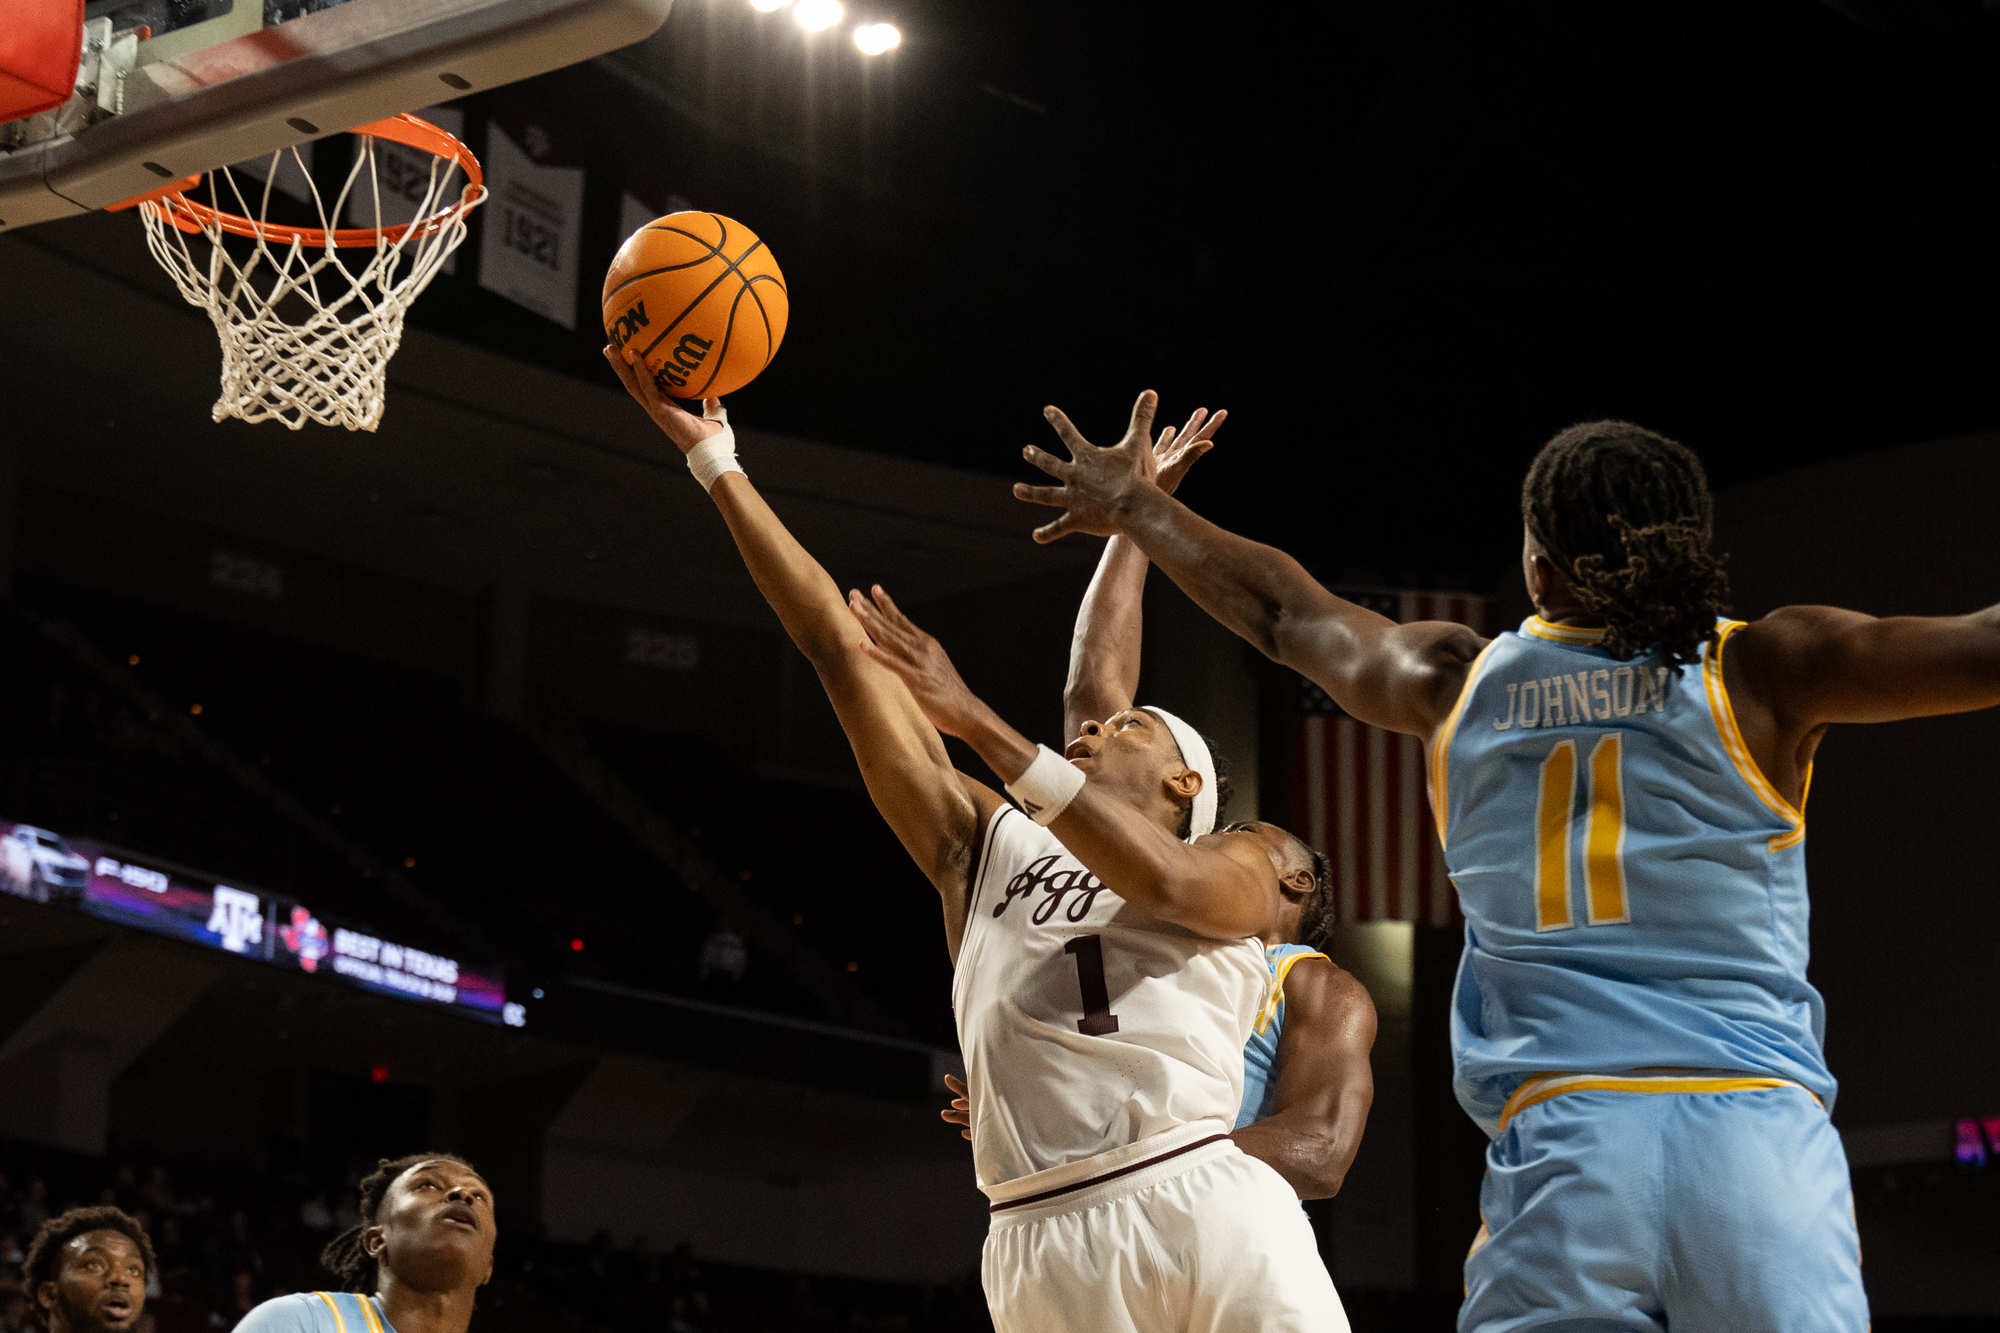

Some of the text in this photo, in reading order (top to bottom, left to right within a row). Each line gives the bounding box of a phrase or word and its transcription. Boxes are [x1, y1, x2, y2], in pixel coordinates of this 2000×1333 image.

[503, 208, 559, 271] 1921
[1493, 666, 1669, 730] JOHNSON
[1535, 732, 1631, 933] 11
[379, 940, 405, 970] IN
[1064, 934, 1120, 1037] 1
